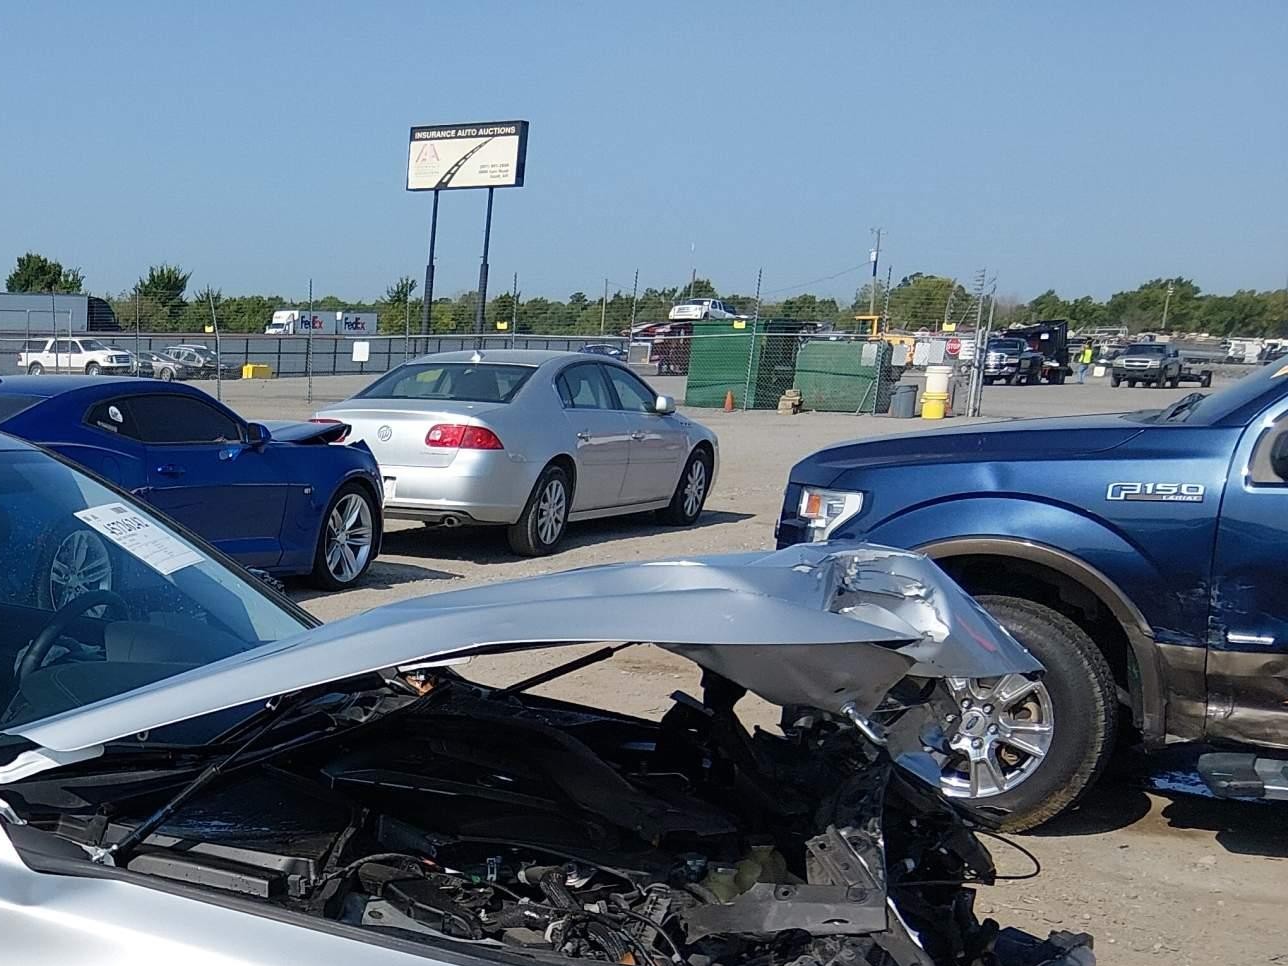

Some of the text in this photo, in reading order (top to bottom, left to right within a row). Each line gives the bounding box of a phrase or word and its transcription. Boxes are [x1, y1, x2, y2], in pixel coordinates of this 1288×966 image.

[414, 126, 516, 139] INSURANCE AUTO AUCTIONS
[300, 315, 323, 329] FedEx
[344, 317, 365, 330] FedEx
